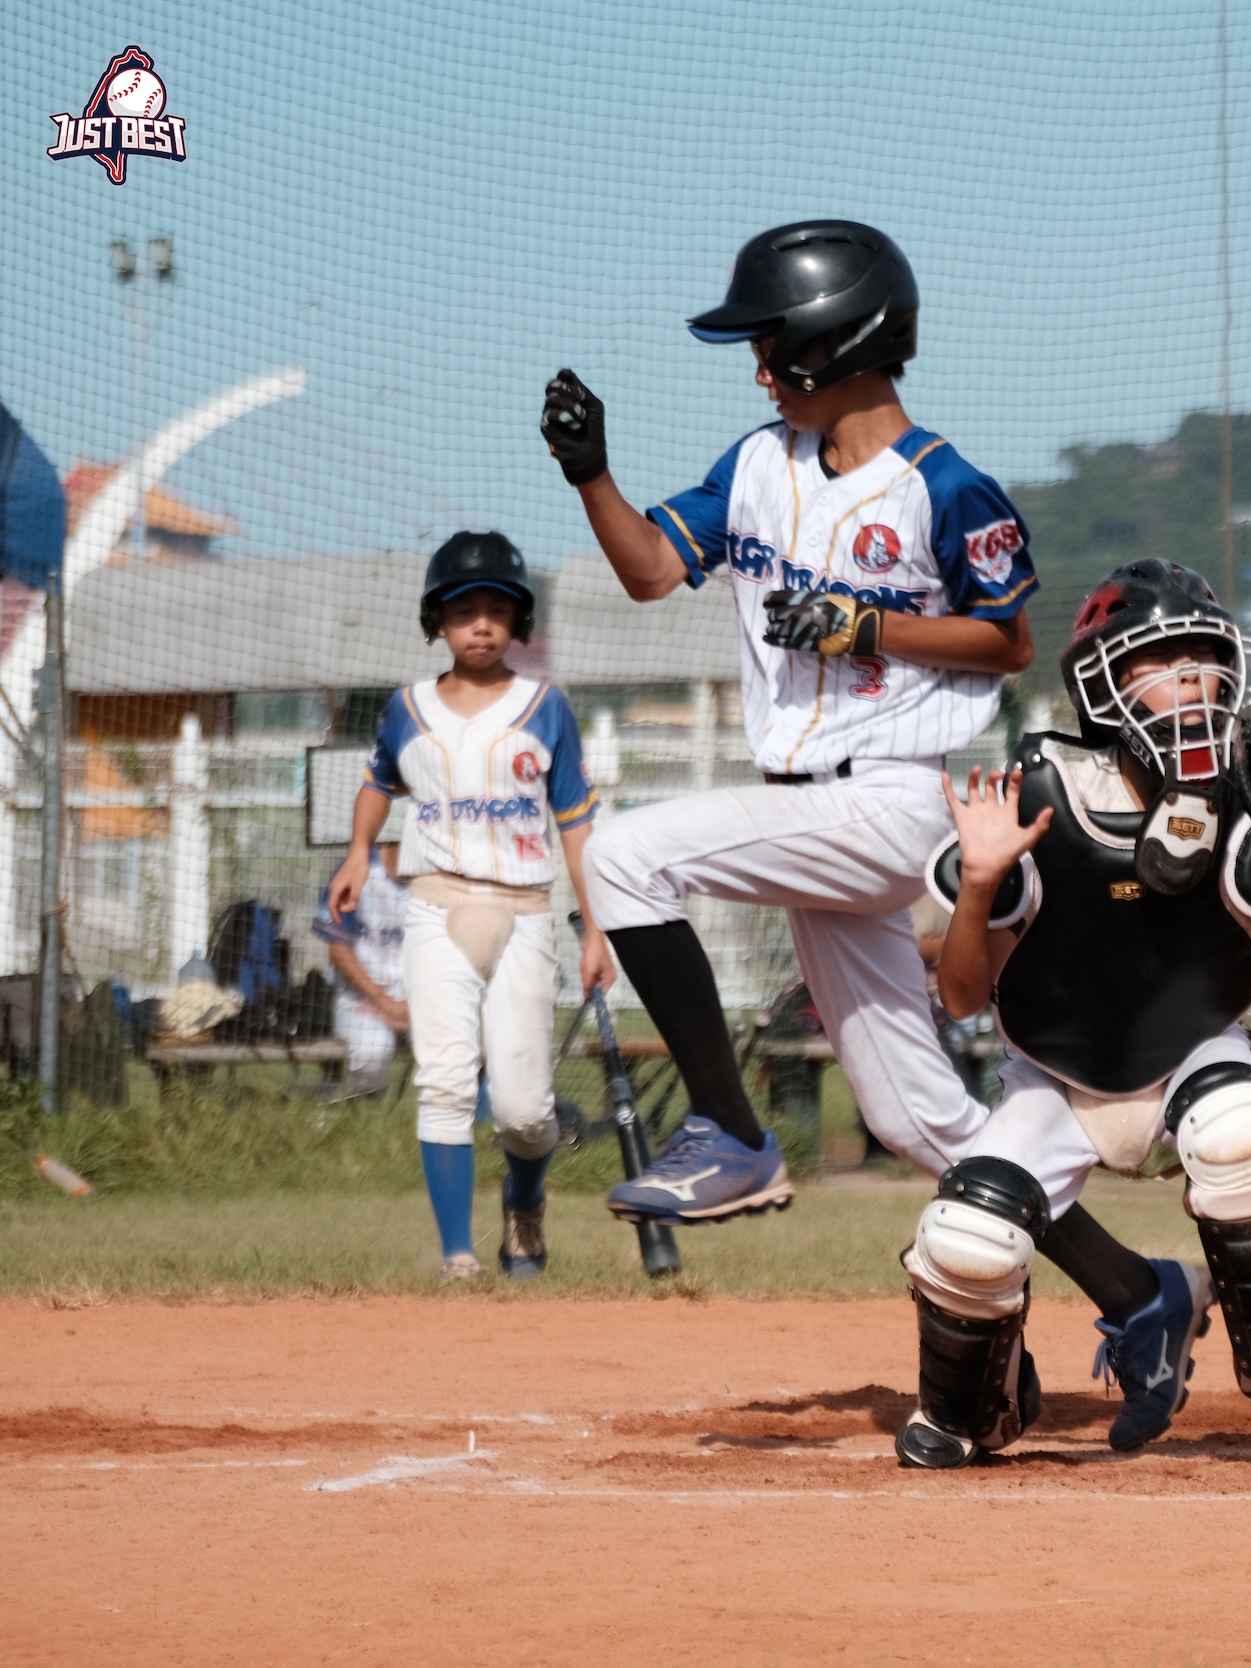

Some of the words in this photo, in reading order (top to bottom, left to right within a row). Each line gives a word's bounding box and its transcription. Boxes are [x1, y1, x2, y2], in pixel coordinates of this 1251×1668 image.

[849, 655, 889, 702] 3
[1171, 820, 1203, 834] ZETT
[512, 834, 546, 861] 15
